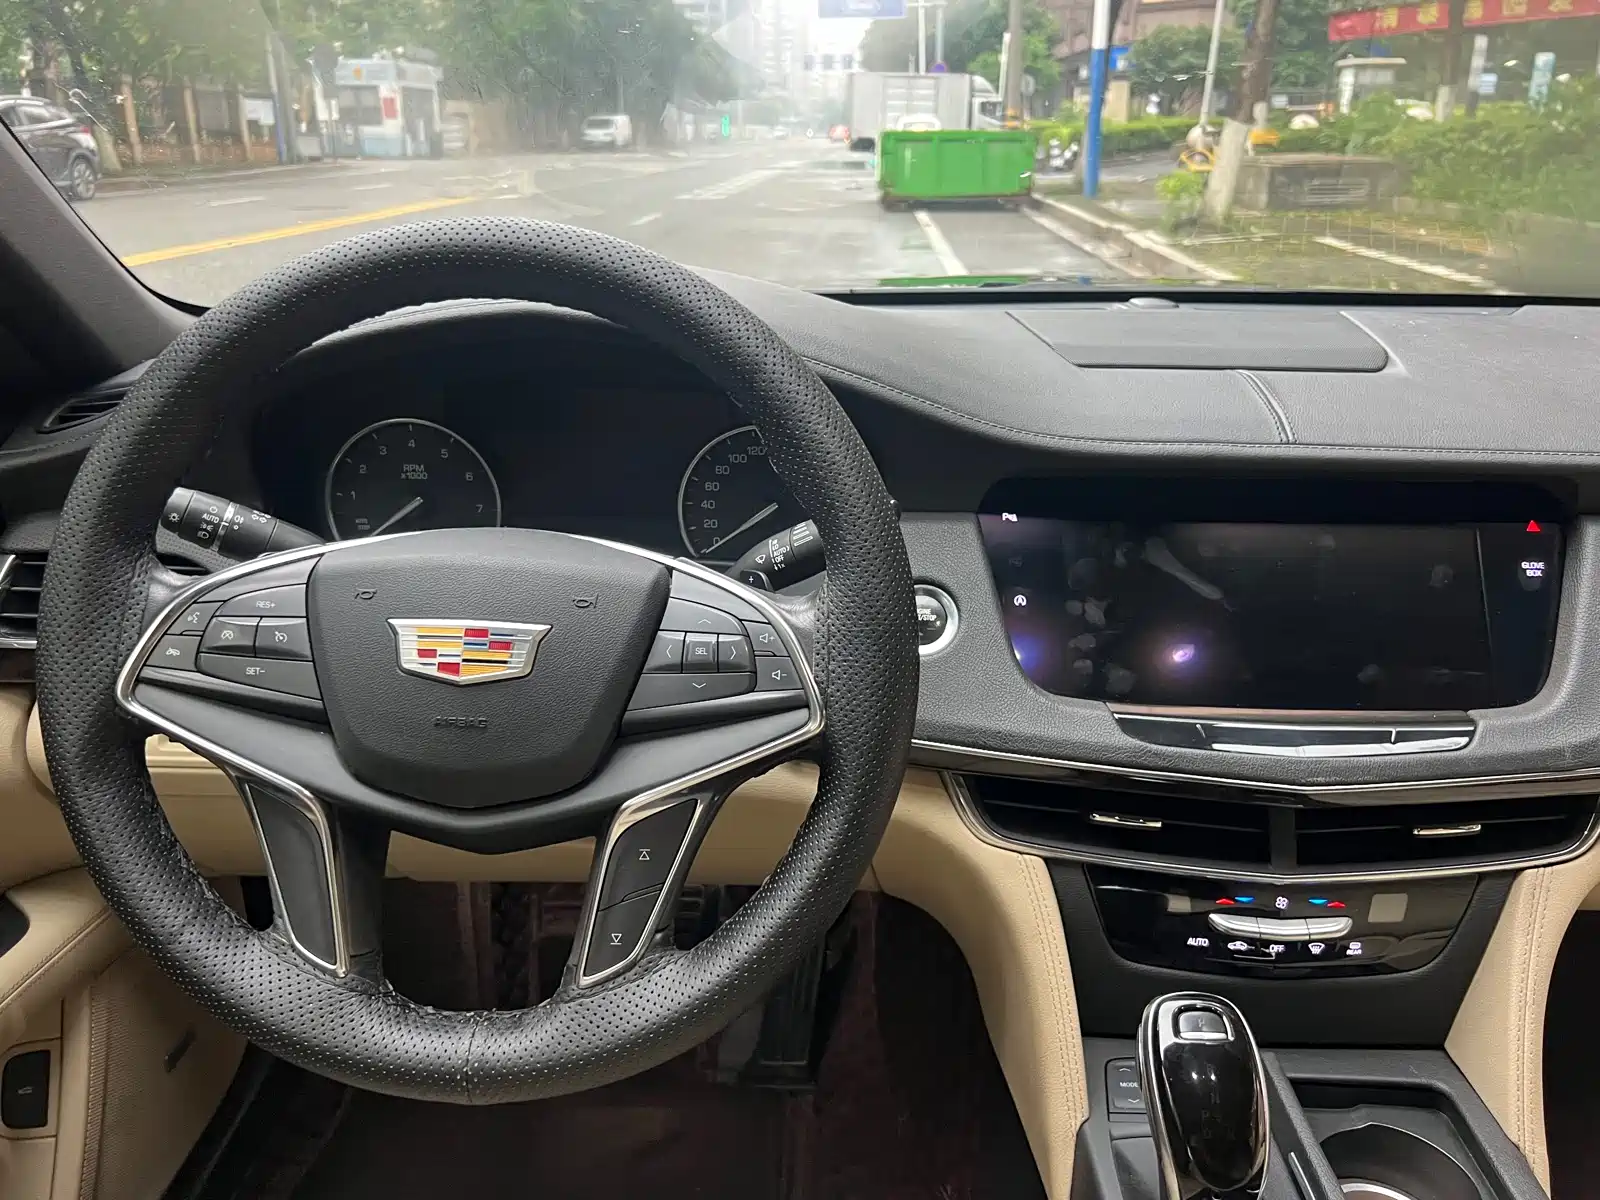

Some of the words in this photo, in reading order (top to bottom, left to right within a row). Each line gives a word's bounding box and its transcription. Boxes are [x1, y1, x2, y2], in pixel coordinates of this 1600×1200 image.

[408, 439, 416, 448] 4
[379, 446, 388, 456] 3
[440, 449, 449, 459] 5
[747, 446, 765, 456] 120
[727, 454, 748, 464] 100
[359, 464, 367, 474] 2
[403, 464, 425, 472] RPM
[715, 465, 730, 475] 80
[465, 472, 474, 482] 6
[704, 482, 720, 492] 60
[350, 490, 356, 500] 1
[475, 504, 483, 513] 7
[700, 500, 716, 509] 40
[202, 513, 220, 524] AUTO
[703, 519, 718, 529] 20
[773, 546, 786, 557] AUTO
[774, 554, 784, 563] OFF
[1521, 561, 1545, 569] GLOVE
[1526, 569, 1543, 577] BOX
[695, 647, 708, 655] SEL
[433, 715, 488, 728] AIRBAG
[1187, 937, 1210, 948] AUTO
[1269, 944, 1286, 953] OFF
